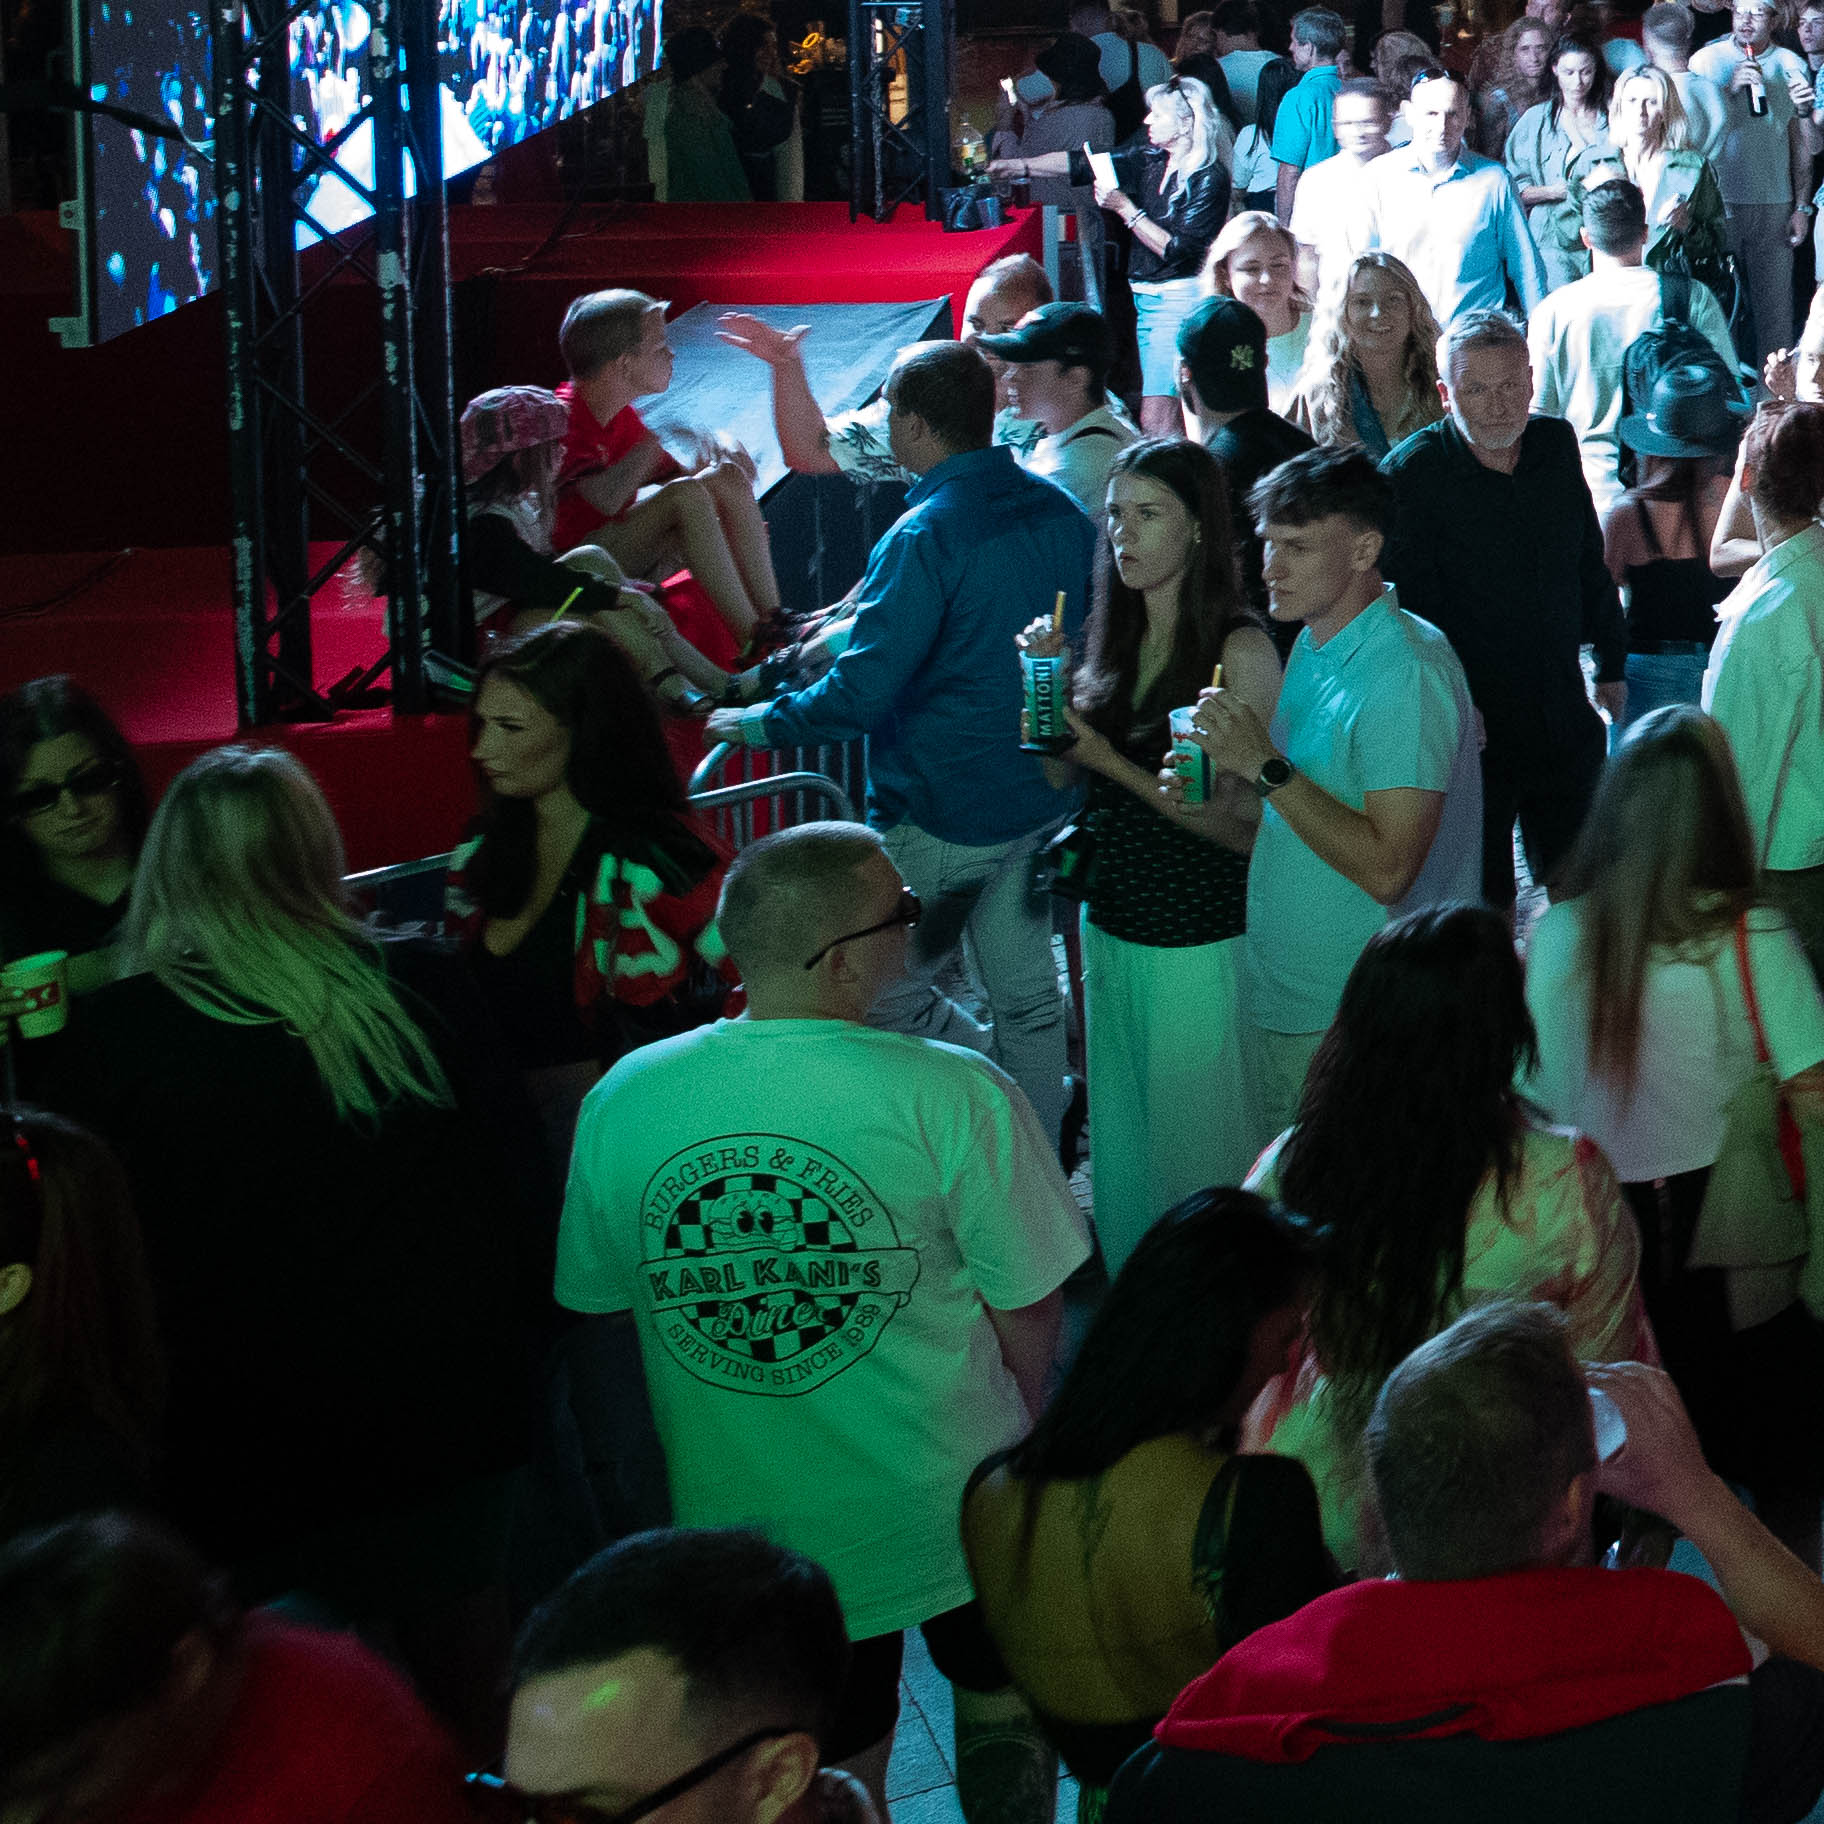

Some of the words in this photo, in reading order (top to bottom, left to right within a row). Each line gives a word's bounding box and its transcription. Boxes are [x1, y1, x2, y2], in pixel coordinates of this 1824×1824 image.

[1034, 660, 1053, 737] MATTONI
[645, 1145, 760, 1234] BURGERS
[768, 1147, 794, 1172] &
[798, 1157, 875, 1227] FRIES
[649, 1262, 746, 1301] KARL
[667, 1324, 765, 1382] SERVING
[772, 1341, 844, 1386] SINCE
